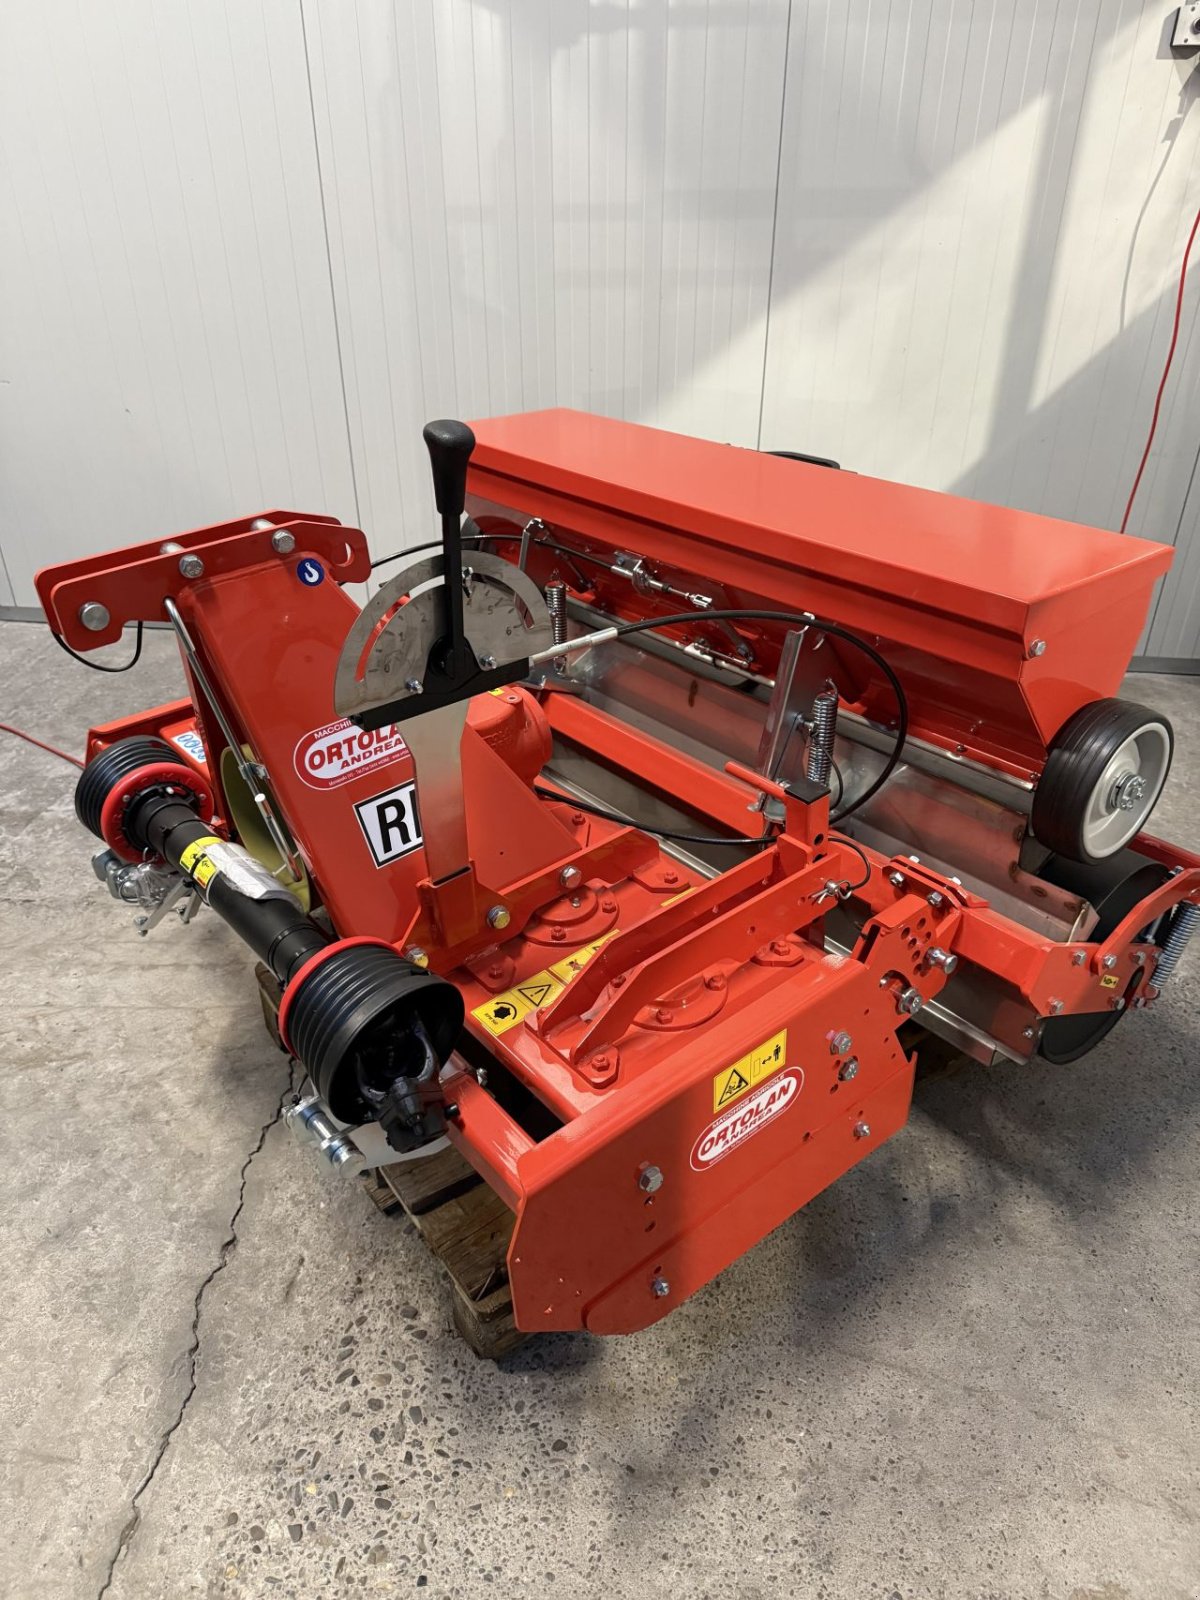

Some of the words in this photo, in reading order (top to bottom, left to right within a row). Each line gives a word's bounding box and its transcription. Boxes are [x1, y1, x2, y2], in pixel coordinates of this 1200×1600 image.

[340, 737, 403, 770] ANDREA
[699, 1079, 792, 1157] ORTOLAN
[721, 1107, 773, 1149] ANDREA
